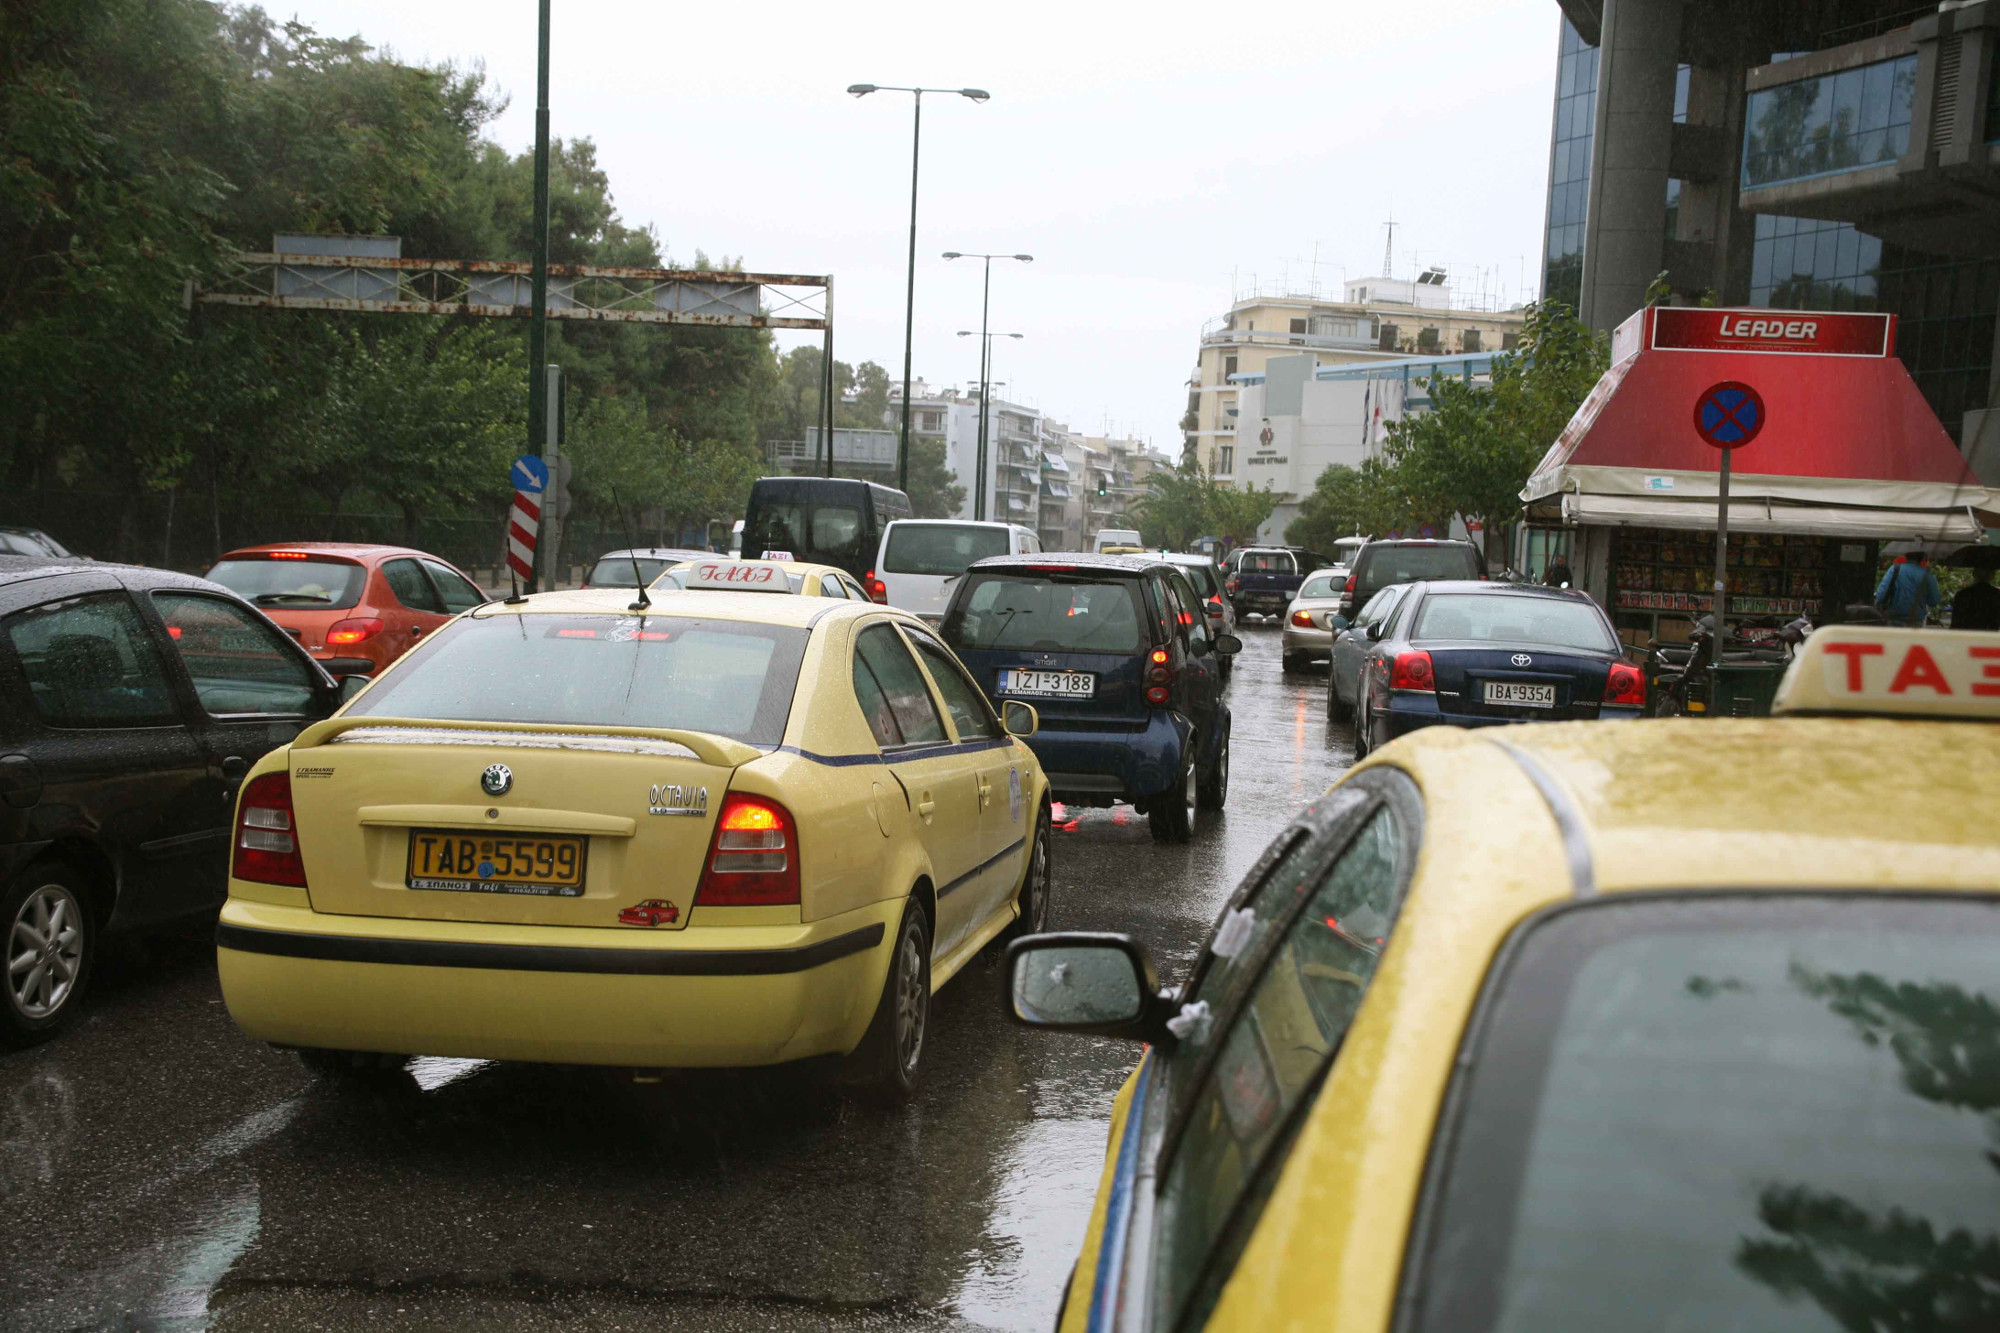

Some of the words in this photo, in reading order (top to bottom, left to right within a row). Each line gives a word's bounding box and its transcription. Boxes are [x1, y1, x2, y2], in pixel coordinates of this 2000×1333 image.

[1720, 315, 1817, 339] LEADER
[699, 565, 774, 582] TAXI
[1034, 657, 1057, 666] smart
[650, 784, 707, 807] OCTAVIA
[427, 881, 469, 890] ΣΠΑΝΟΣ
